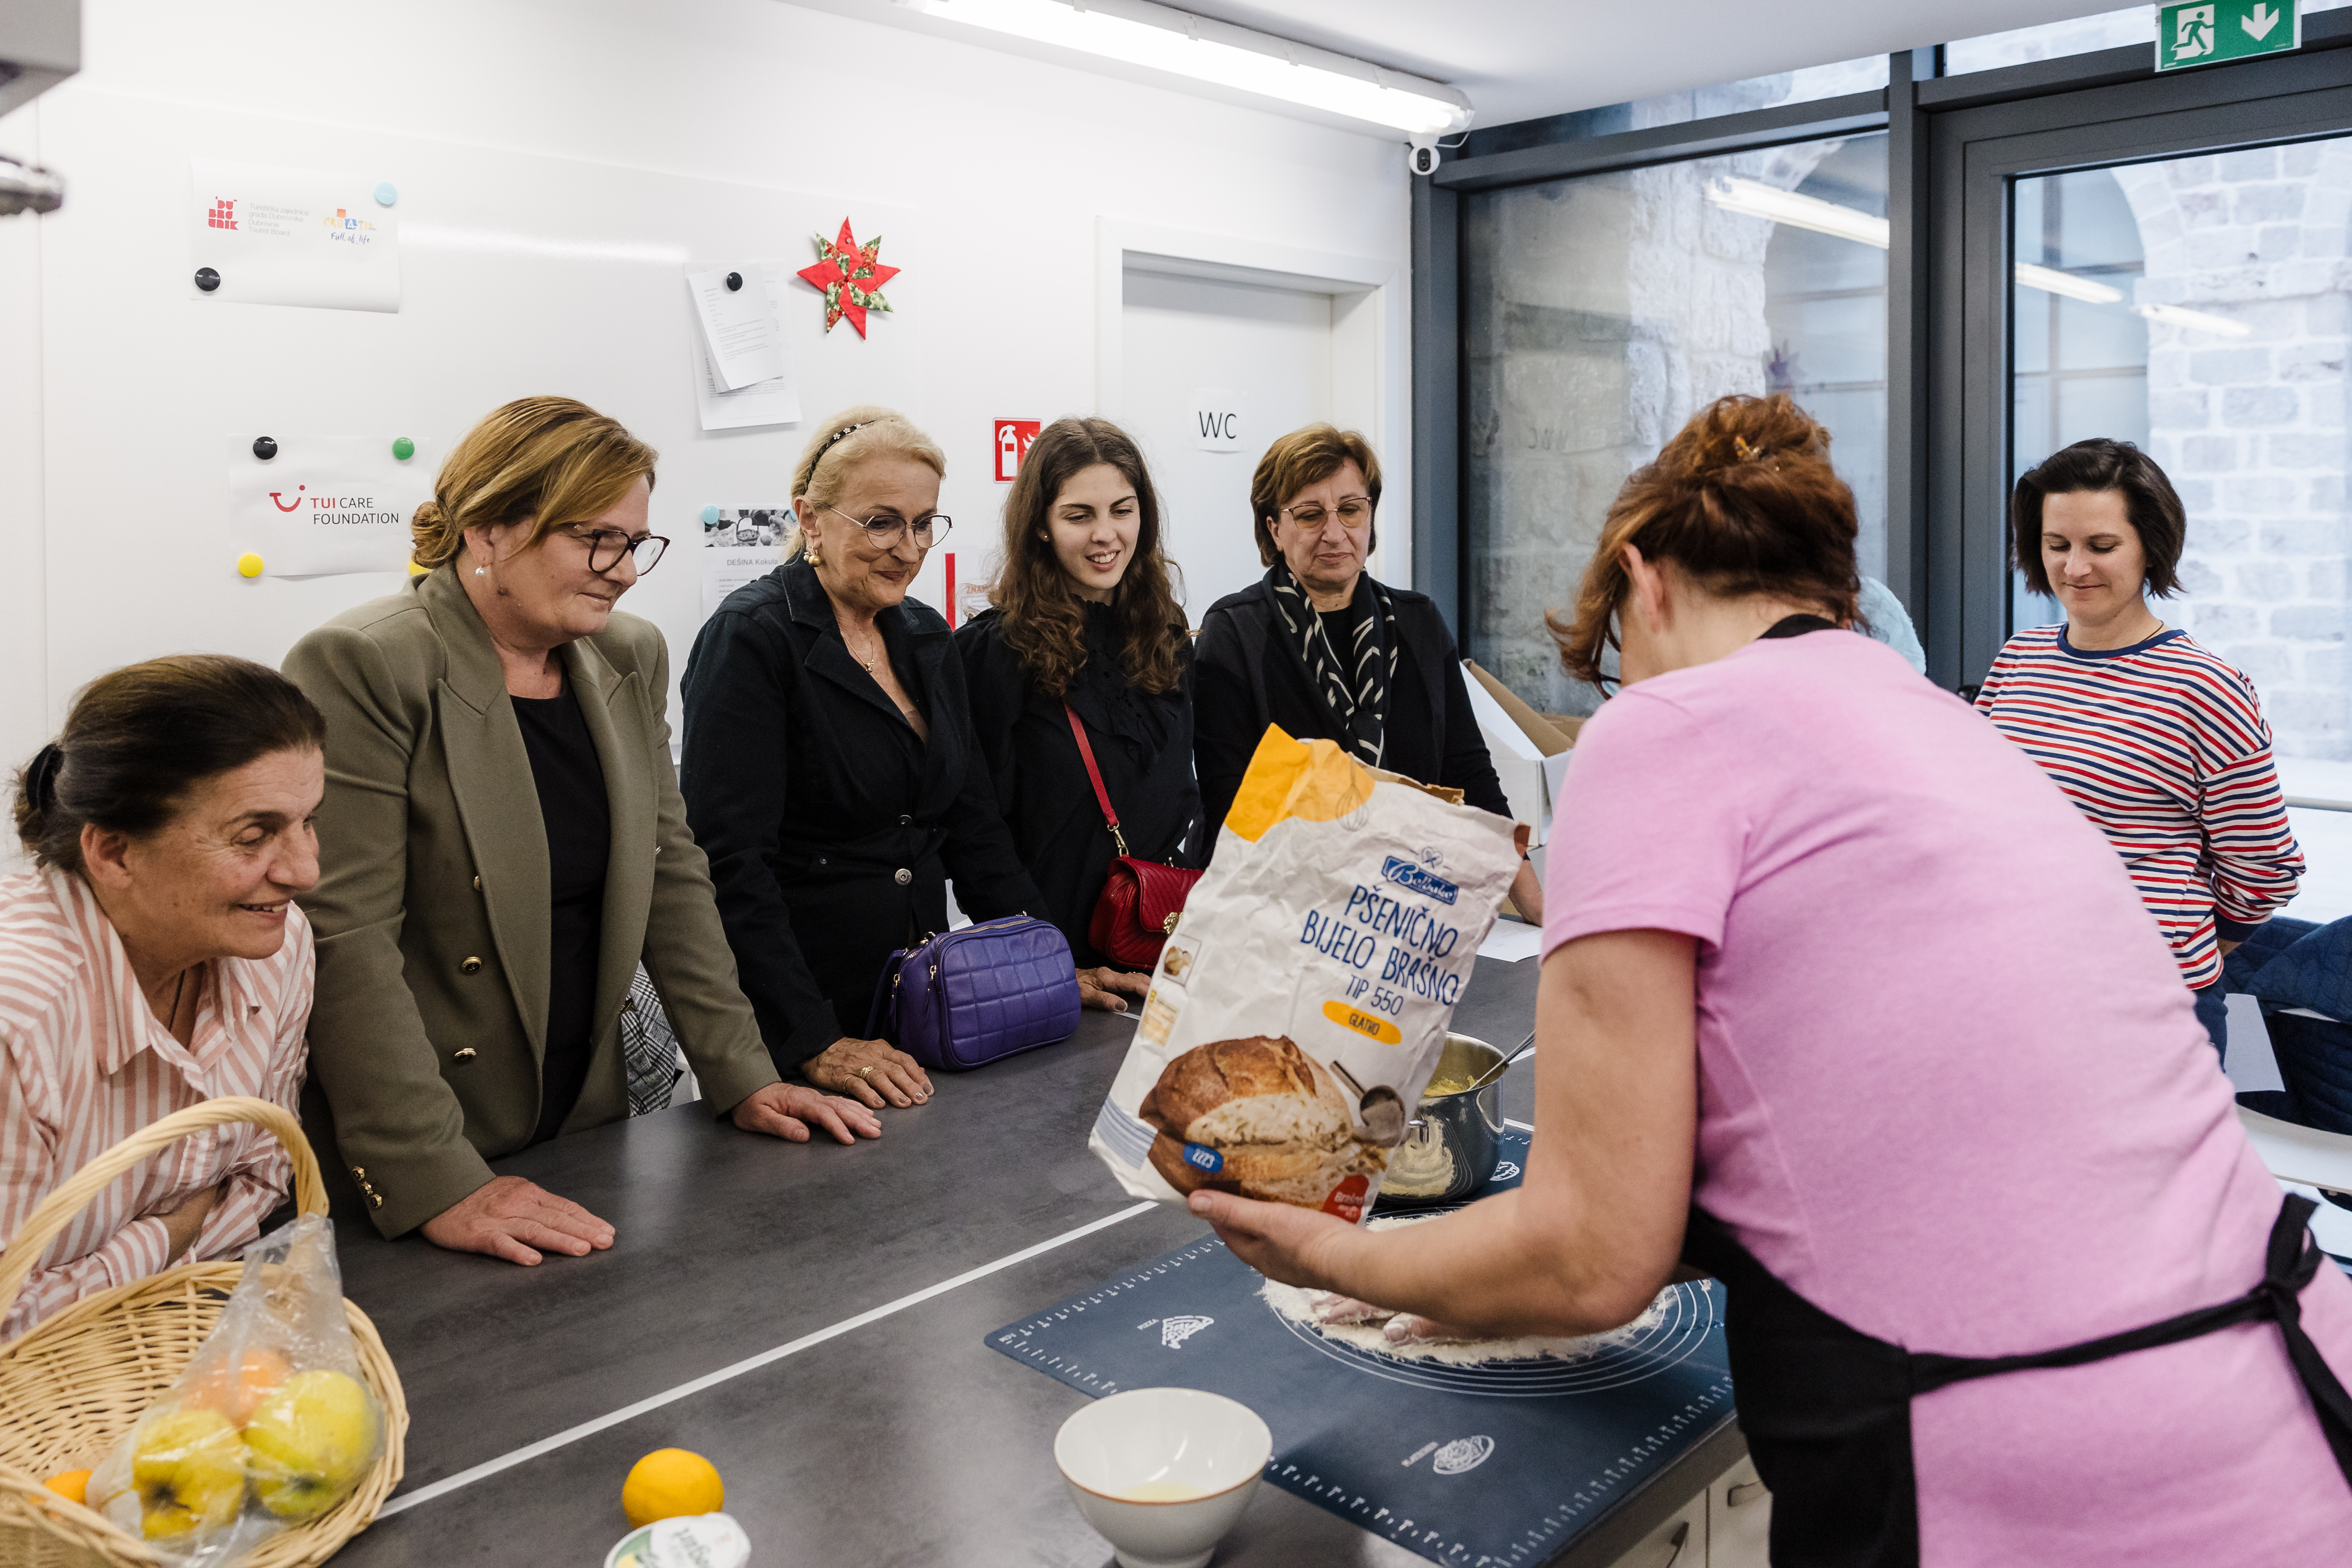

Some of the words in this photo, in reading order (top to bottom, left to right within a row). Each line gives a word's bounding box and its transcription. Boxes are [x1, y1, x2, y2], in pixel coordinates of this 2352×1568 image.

[249, 203, 279, 212] Turistička
[280, 207, 309, 216] zajednica
[248, 218, 280, 228] Dubrovnik
[269, 213, 304, 222] Dubrovnika
[324, 216, 377, 231] CROATIA
[1199, 411, 1237, 439] WC
[310, 498, 336, 509] TUI
[339, 497, 373, 509] CARE
[314, 513, 399, 525] FOUNDATION
[727, 557, 753, 566] DEŠINA
[1344, 884, 1458, 958] PŠENIČNO
[1300, 909, 1376, 970] BIJELO
[1381, 946, 1459, 1006] BRAŠNO
[1346, 974, 1369, 1000] TIP
[1371, 986, 1404, 1016] 550
